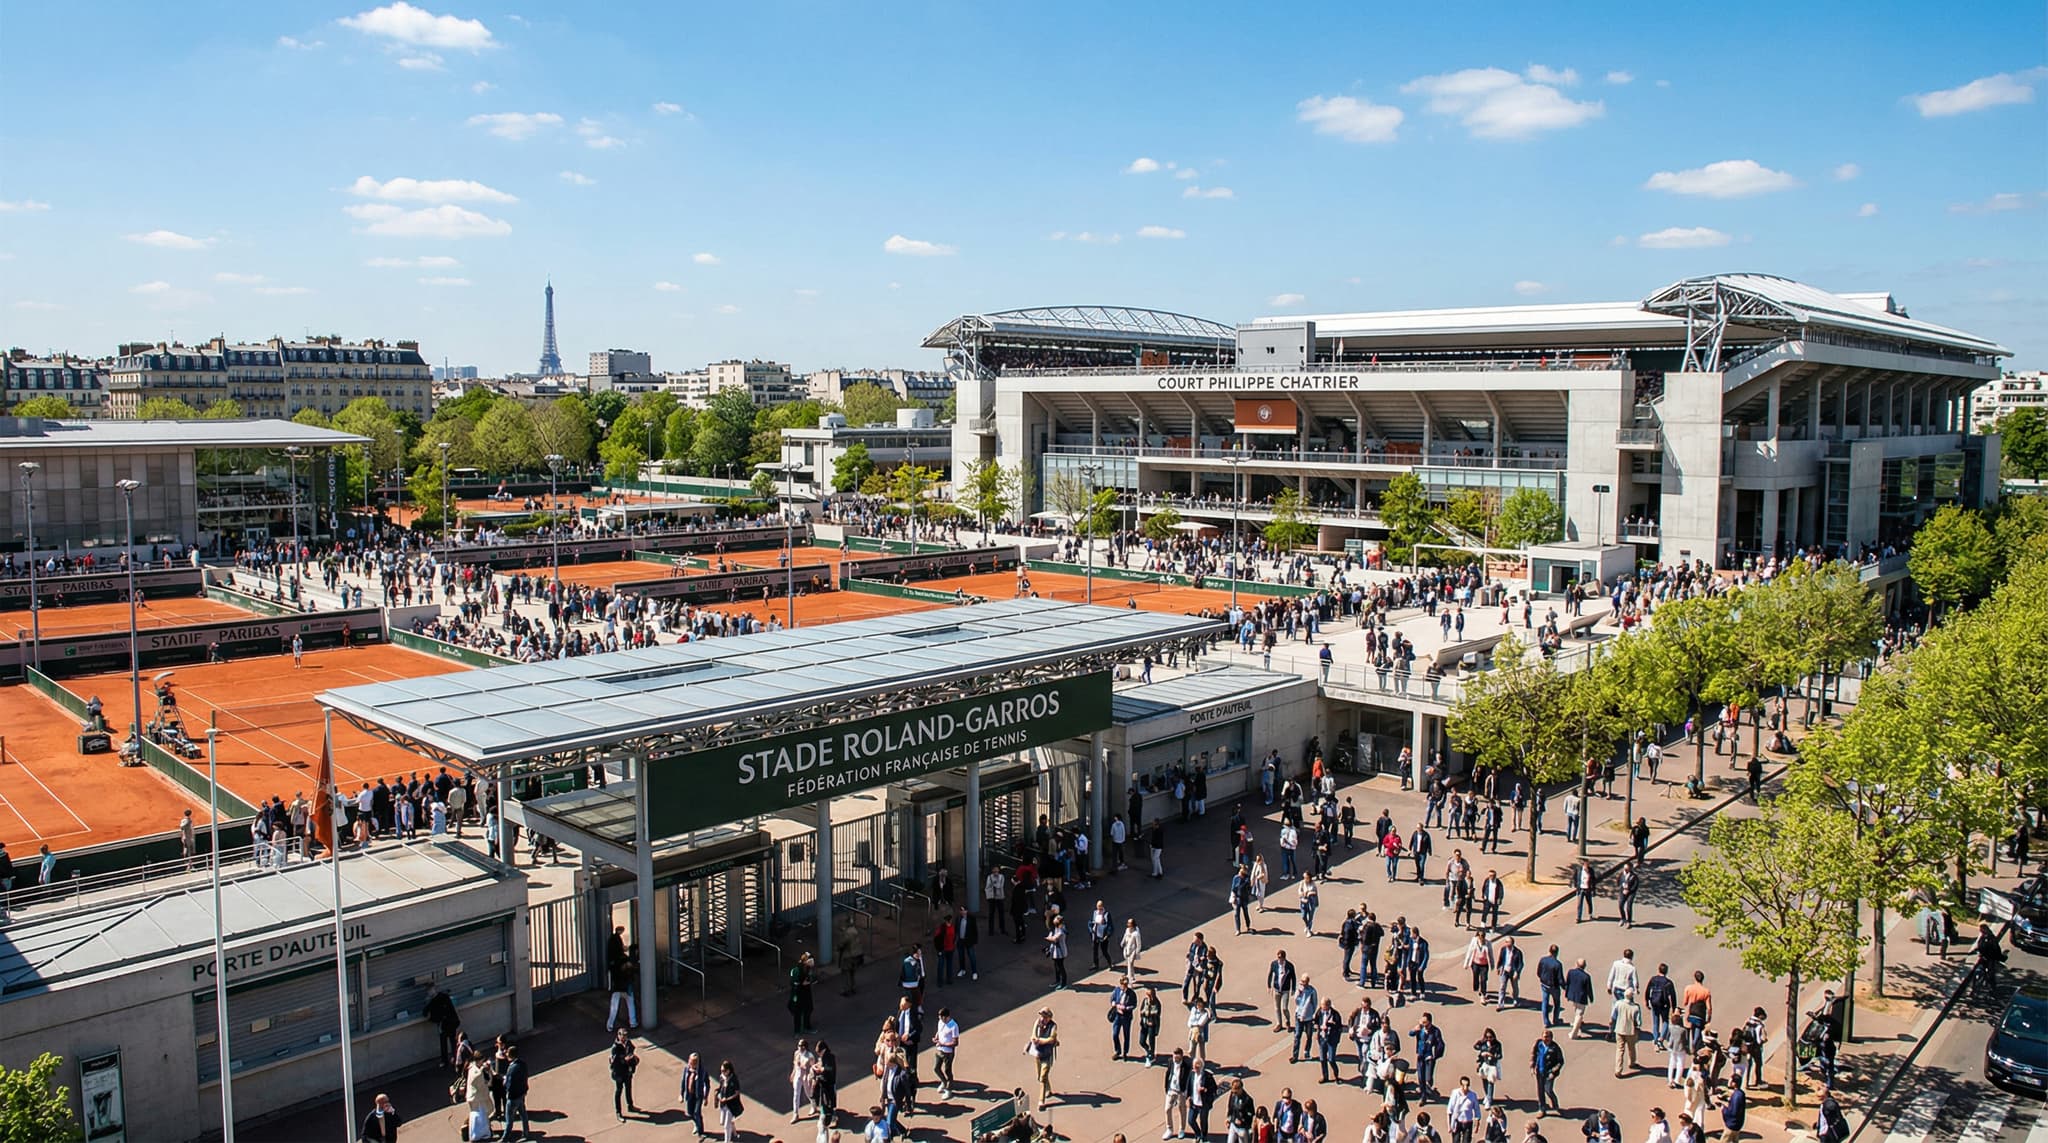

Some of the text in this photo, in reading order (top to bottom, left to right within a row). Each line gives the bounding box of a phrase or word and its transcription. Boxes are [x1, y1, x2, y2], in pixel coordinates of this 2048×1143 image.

[1157, 375, 1359, 390] COURT PHILIPPE CHATRIER
[62, 580, 114, 592] PARIBAS
[219, 624, 280, 642] PARIBAS
[1216, 700, 1252, 718] D'AUTEUIL
[738, 690, 1060, 785] STADE ROLAND-GARROS
[787, 729, 1027, 798] FÉDÉRATION FRANÇAISE DE TENNIS
[192, 923, 371, 981] PORTE D'AUTEUIL
